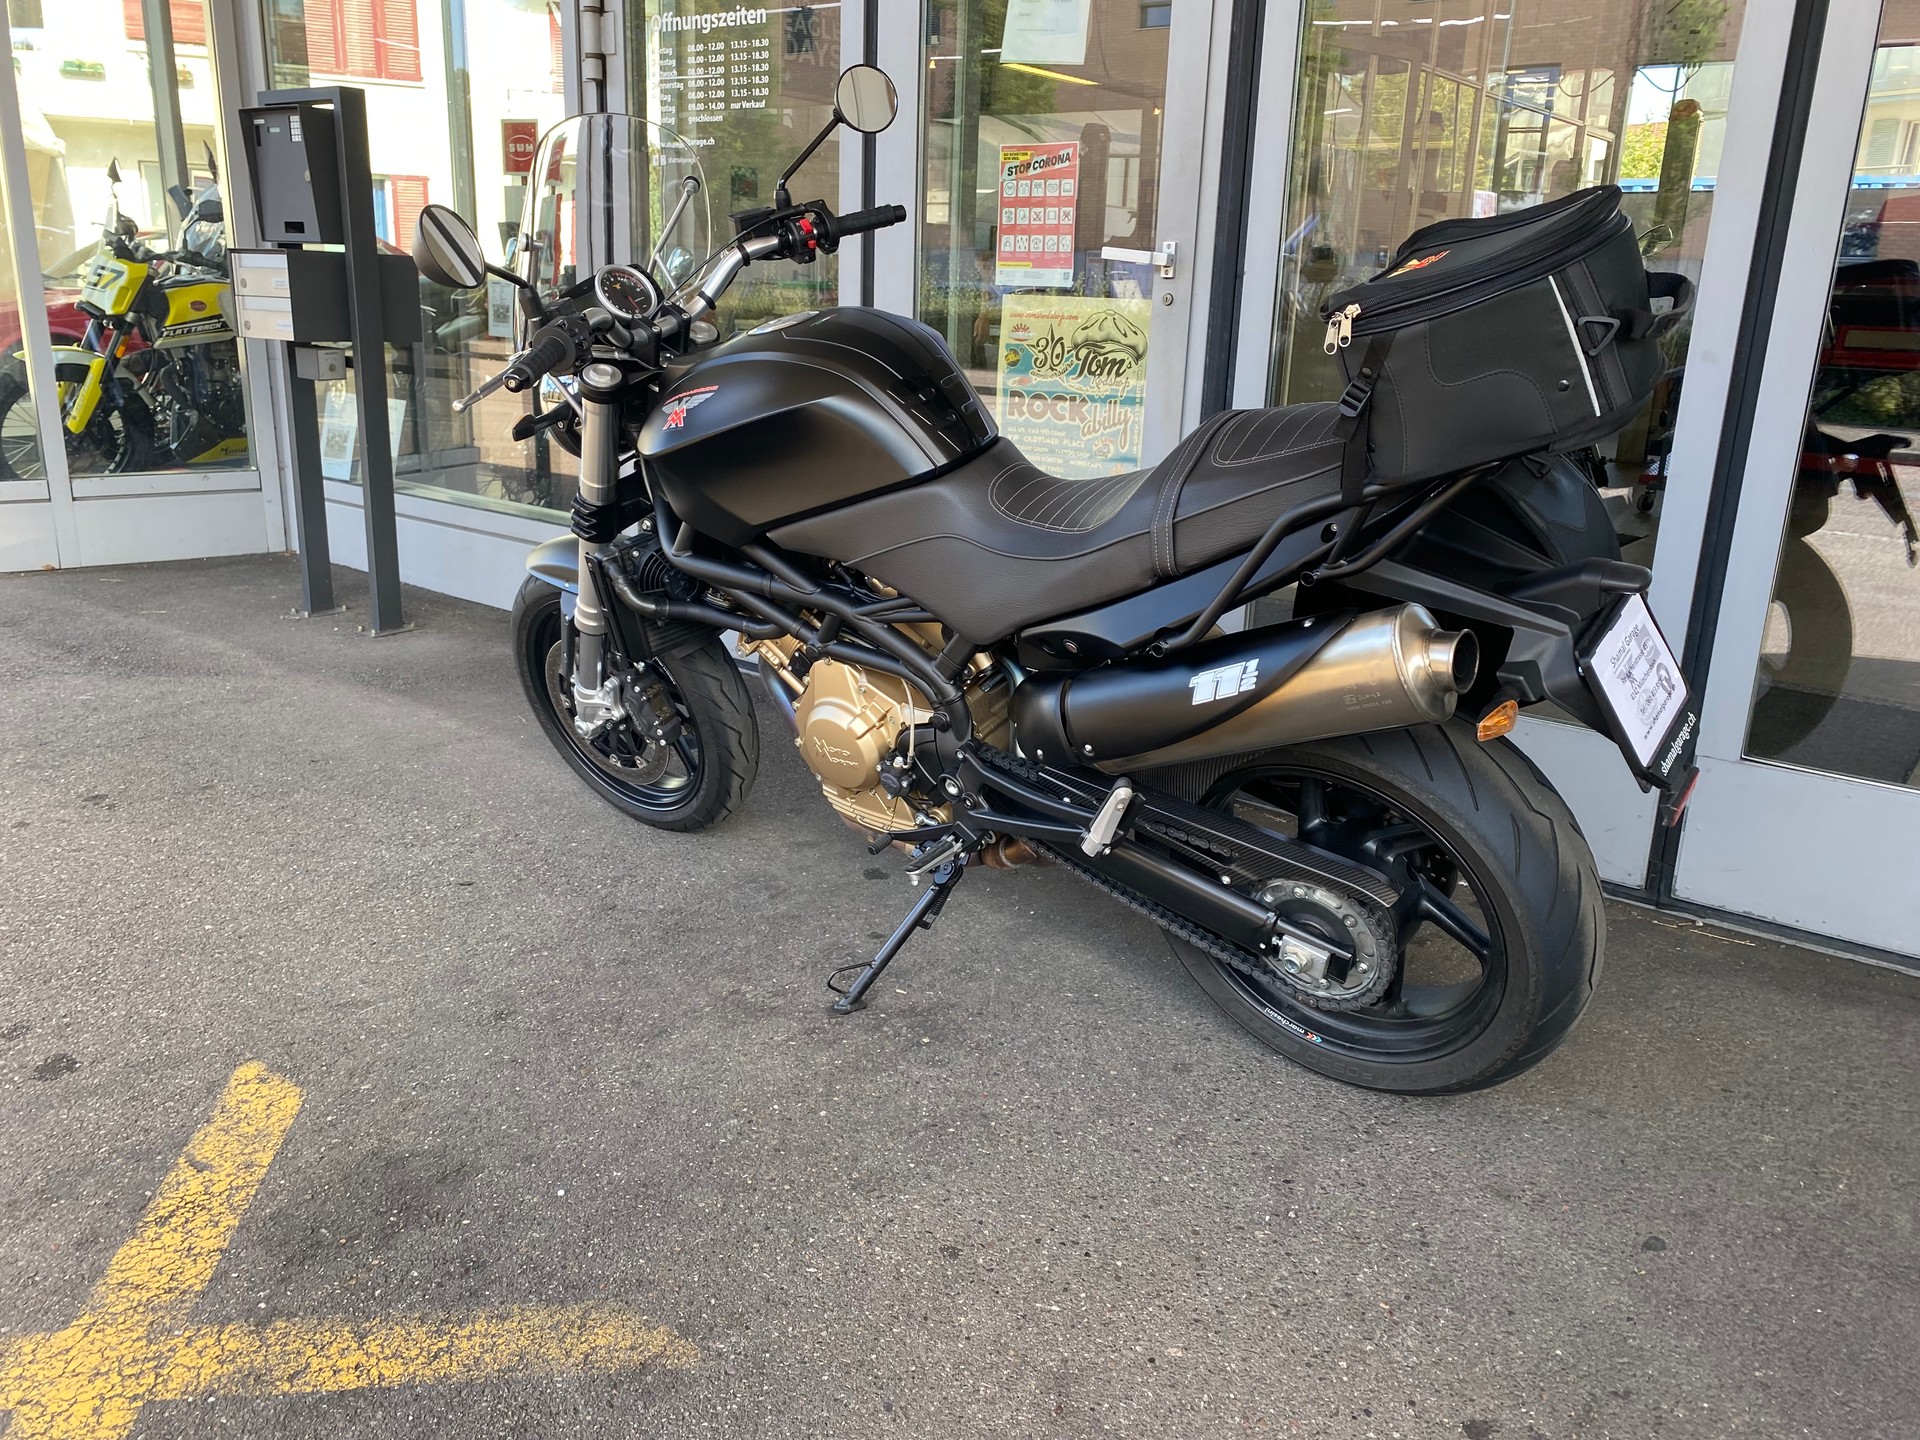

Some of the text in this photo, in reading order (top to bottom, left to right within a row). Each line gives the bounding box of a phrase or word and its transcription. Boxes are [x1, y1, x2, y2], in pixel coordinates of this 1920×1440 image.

[688, 43, 703, 52] 08.00
[708, 42, 724, 50] 12.00
[731, 40, 747, 49] 13.15
[752, 39, 769, 47] 18.30
[688, 55, 703, 64] 08.00
[708, 54, 724, 62] 12.00
[731, 52, 747, 61] 13.15
[752, 51, 769, 59] 18.30
[688, 68, 703, 76] 08.00
[708, 67, 724, 75] 12.00
[731, 65, 747, 73] 13.15
[752, 63, 769, 72] 18.30
[688, 79, 703, 88] 08.00
[731, 77, 747, 85] 13.15
[752, 76, 769, 84] 18.30
[688, 91, 703, 99] 08.00
[752, 88, 769, 96] 18.30
[742, 100, 766, 108] Verkauf
[688, 114, 723, 124] geschlossen
[1007, 152, 1071, 176] STOP CORONA
[162, 322, 222, 338] FLAT TRACK
[1033, 336, 1065, 369] 30
[1071, 341, 1132, 381] Tom's
[1091, 375, 1131, 398] Rodshop
[1007, 390, 1088, 424] ROCK
[1023, 436, 1060, 444] OLDTIMER
[1610, 624, 1640, 668] Shamal Garage
[1661, 712, 1697, 777] shamalgarage.ch
[1264, 1007, 1305, 1034] marchesini
